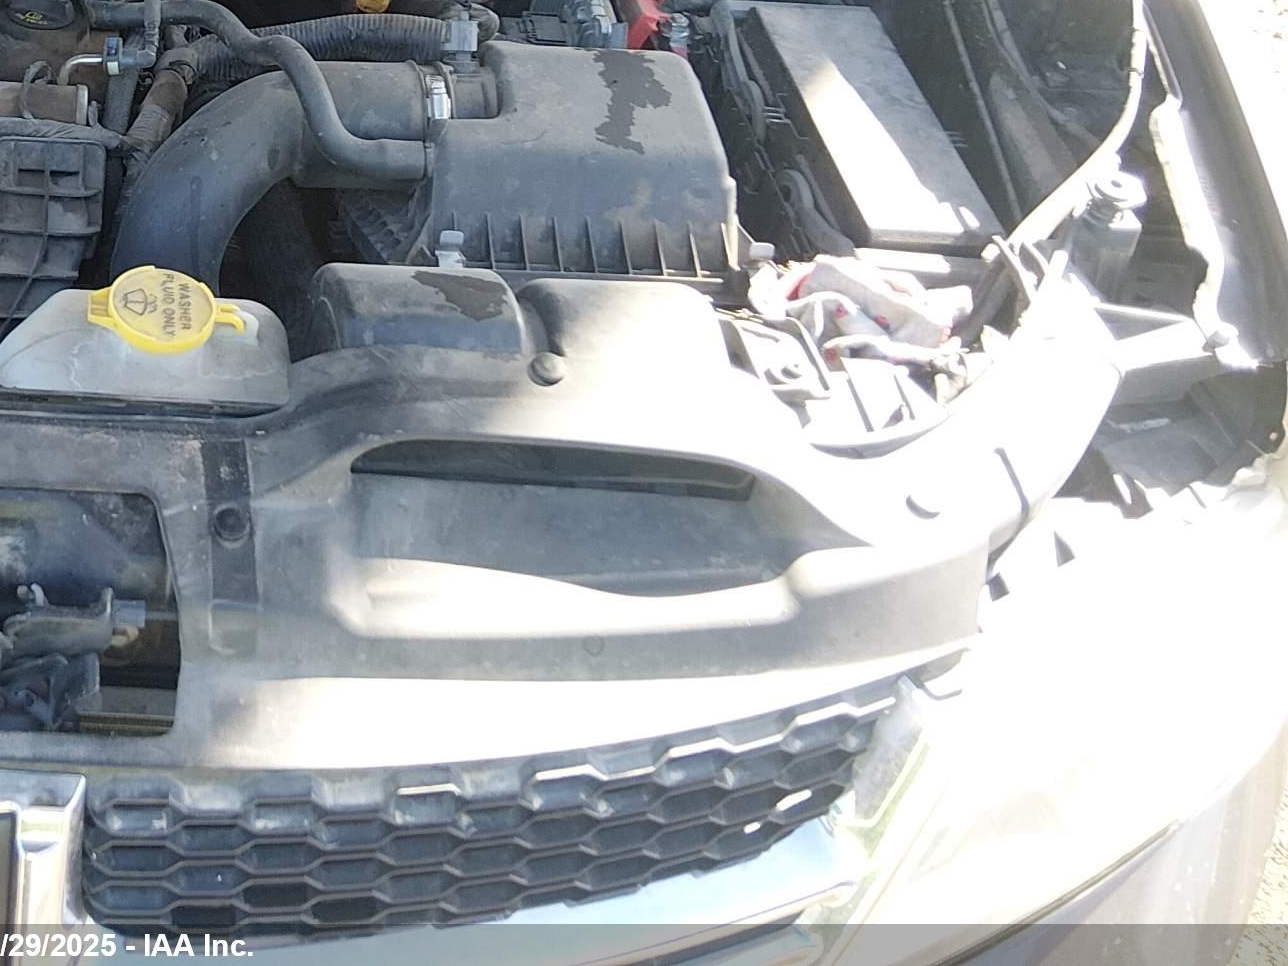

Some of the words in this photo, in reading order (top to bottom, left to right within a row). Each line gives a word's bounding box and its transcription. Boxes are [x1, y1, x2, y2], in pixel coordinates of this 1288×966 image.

[160, 273, 175, 305] FLUID
[178, 282, 192, 331] WASHER
[162, 307, 176, 339] ONLY
